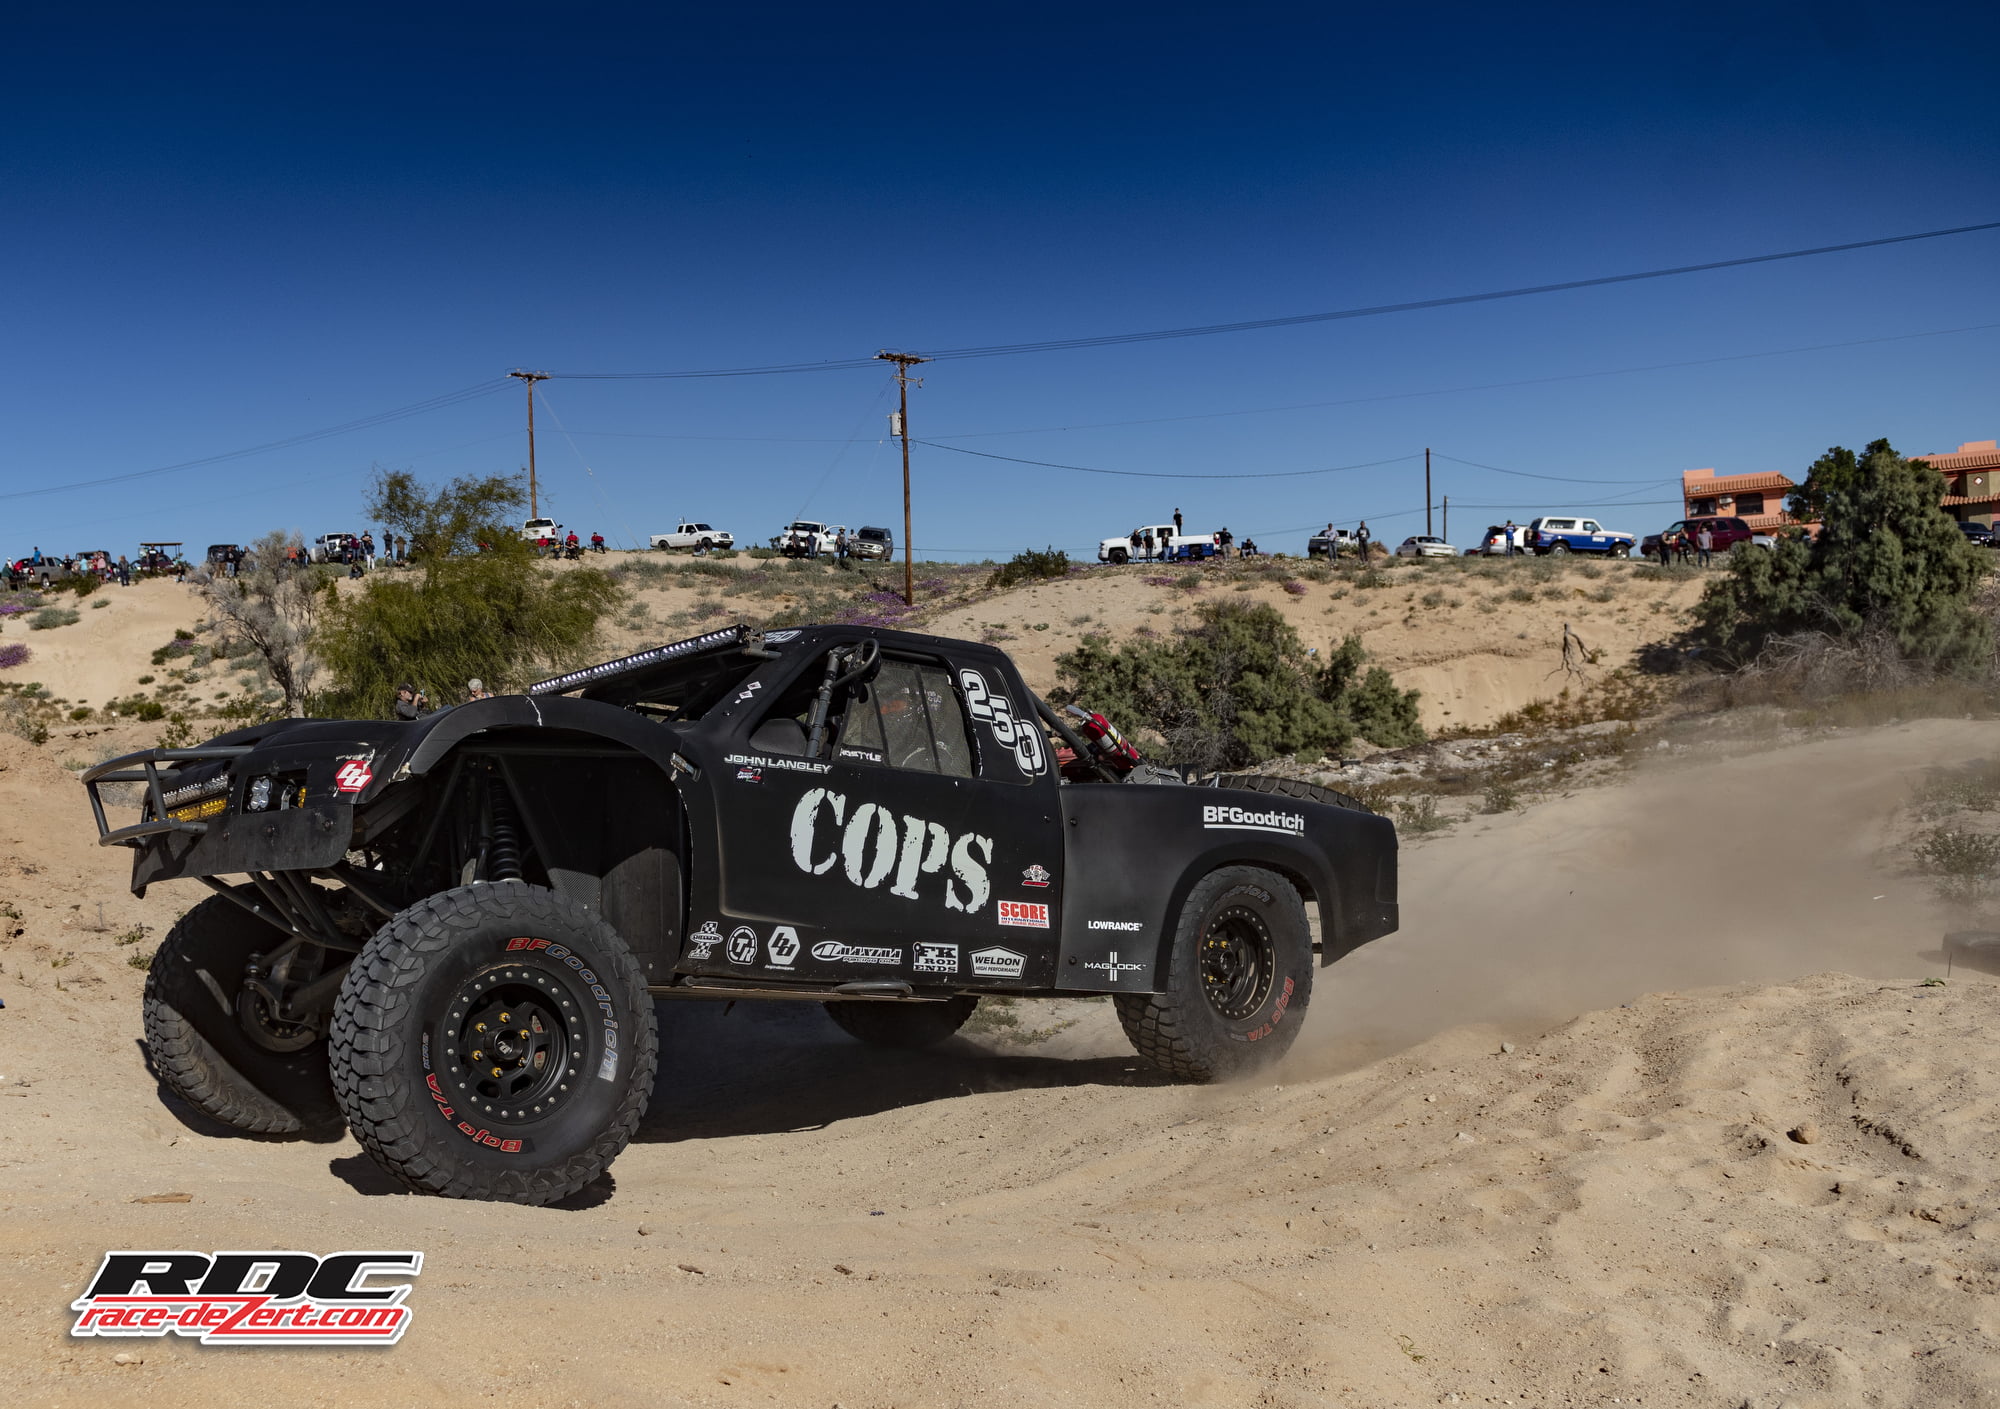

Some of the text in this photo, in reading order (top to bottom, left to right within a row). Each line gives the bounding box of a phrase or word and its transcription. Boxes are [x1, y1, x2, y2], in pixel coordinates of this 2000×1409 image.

[959, 667, 1048, 778] 250
[724, 754, 766, 766] JOHN
[767, 759, 833, 775] LANGLEY
[1203, 805, 1305, 831] BFGoodrich
[790, 787, 994, 914] COPS
[1000, 902, 1047, 920] SCORE
[1088, 920, 1141, 931] LOWRANCE
[919, 944, 956, 958] FK
[914, 964, 957, 973] ENDS
[924, 958, 956, 966] ROD
[975, 956, 1021, 966] WELDON
[1084, 962, 1142, 971] MAGLOCK
[505, 937, 619, 1069] BFGoodrich
[426, 1073, 455, 1120] T/A
[457, 1121, 523, 1153] Baja
